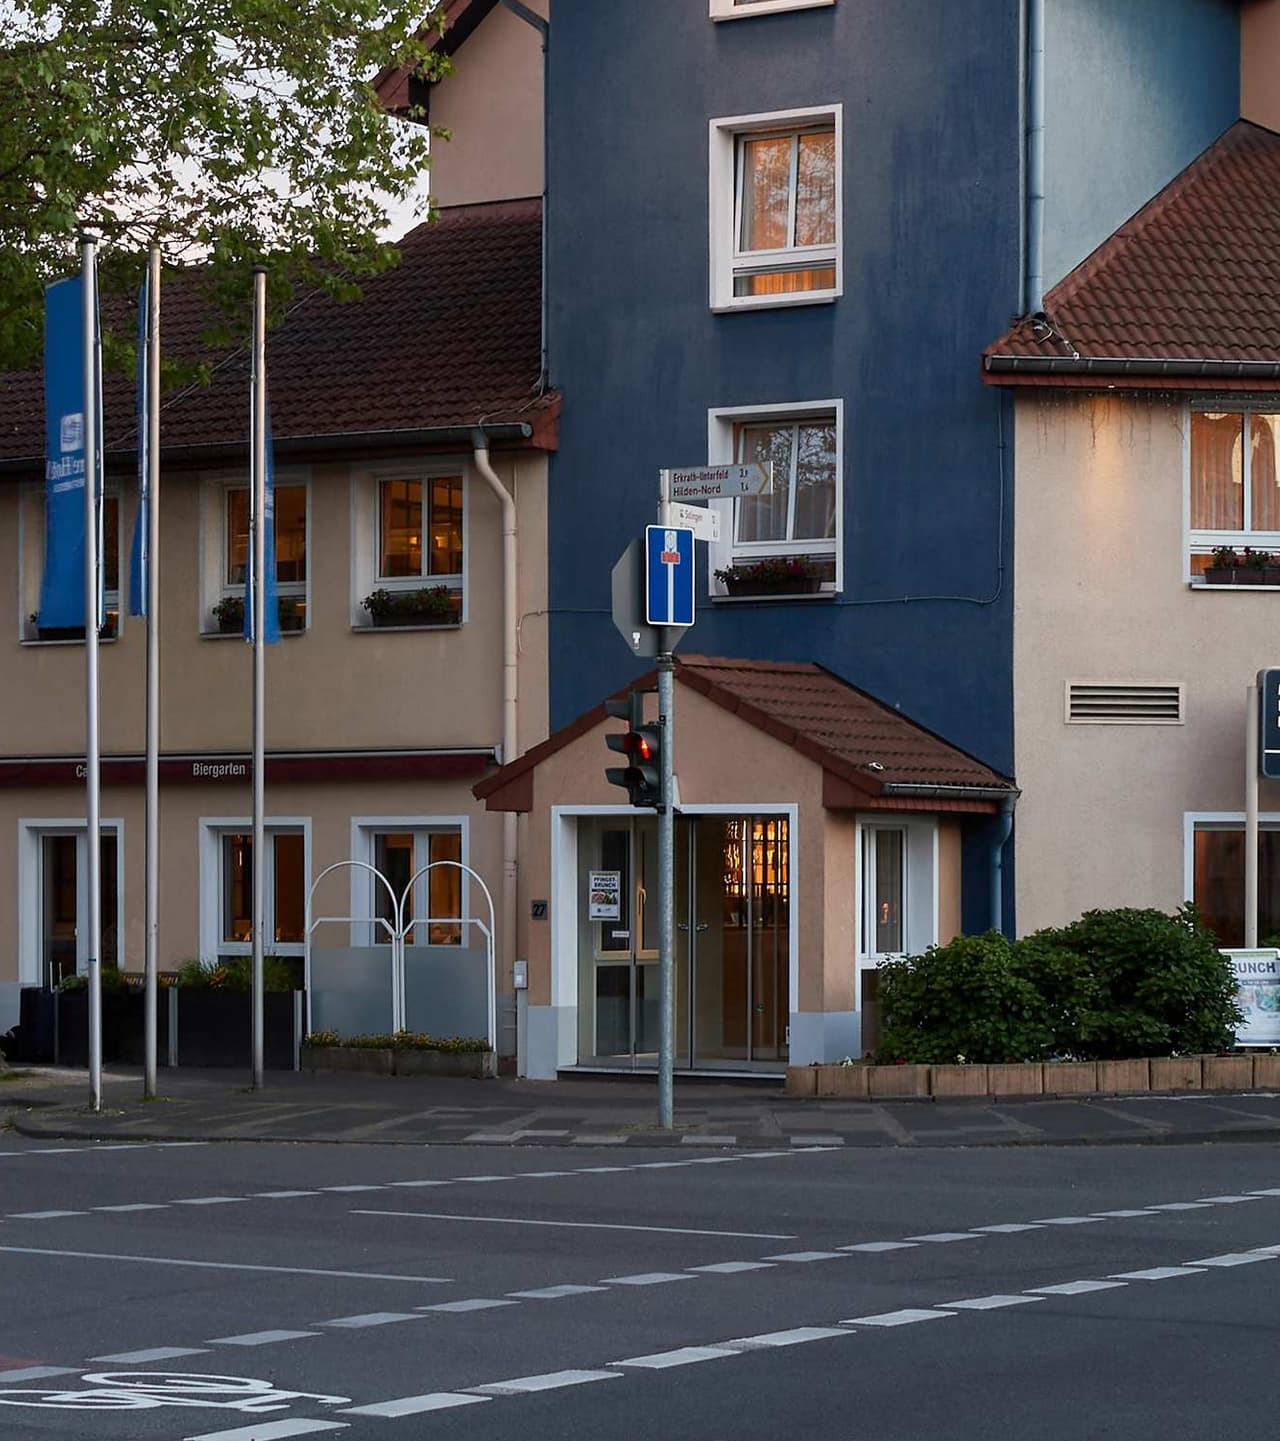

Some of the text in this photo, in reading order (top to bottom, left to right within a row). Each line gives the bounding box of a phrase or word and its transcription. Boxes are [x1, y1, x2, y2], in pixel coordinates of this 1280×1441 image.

[673, 484, 721, 497] Hilden-Nord
[193, 763, 246, 778] Biergarten
[533, 903, 547, 917] 27
[1230, 962, 1276, 973] RUNCH
